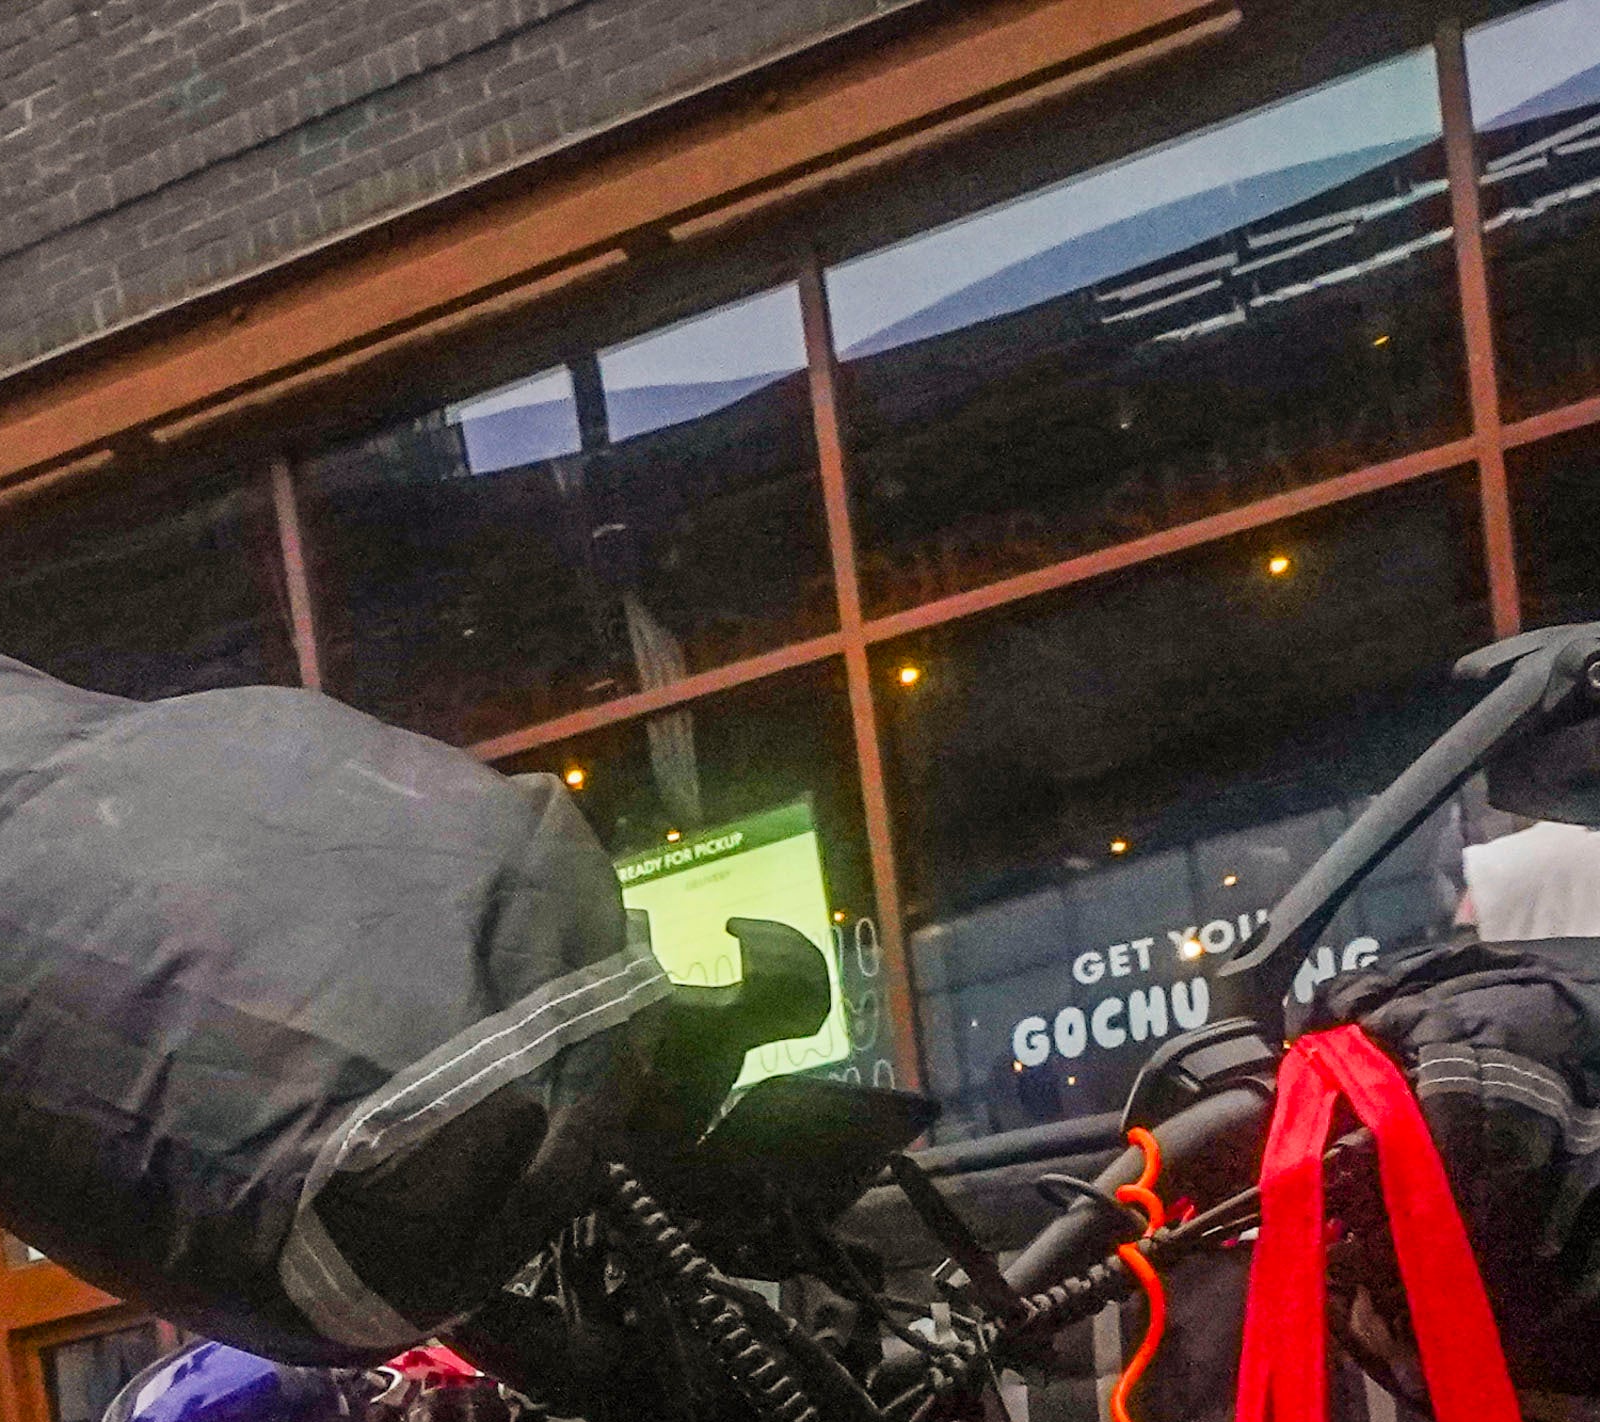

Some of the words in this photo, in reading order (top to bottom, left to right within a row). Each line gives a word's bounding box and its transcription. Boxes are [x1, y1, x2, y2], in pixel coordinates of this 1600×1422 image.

[618, 857, 663, 883] READY
[664, 847, 694, 869] FOR
[694, 832, 743, 858] PICKUP
[1071, 937, 1154, 985] GET
[1012, 936, 1381, 1067] GOCHUNG
